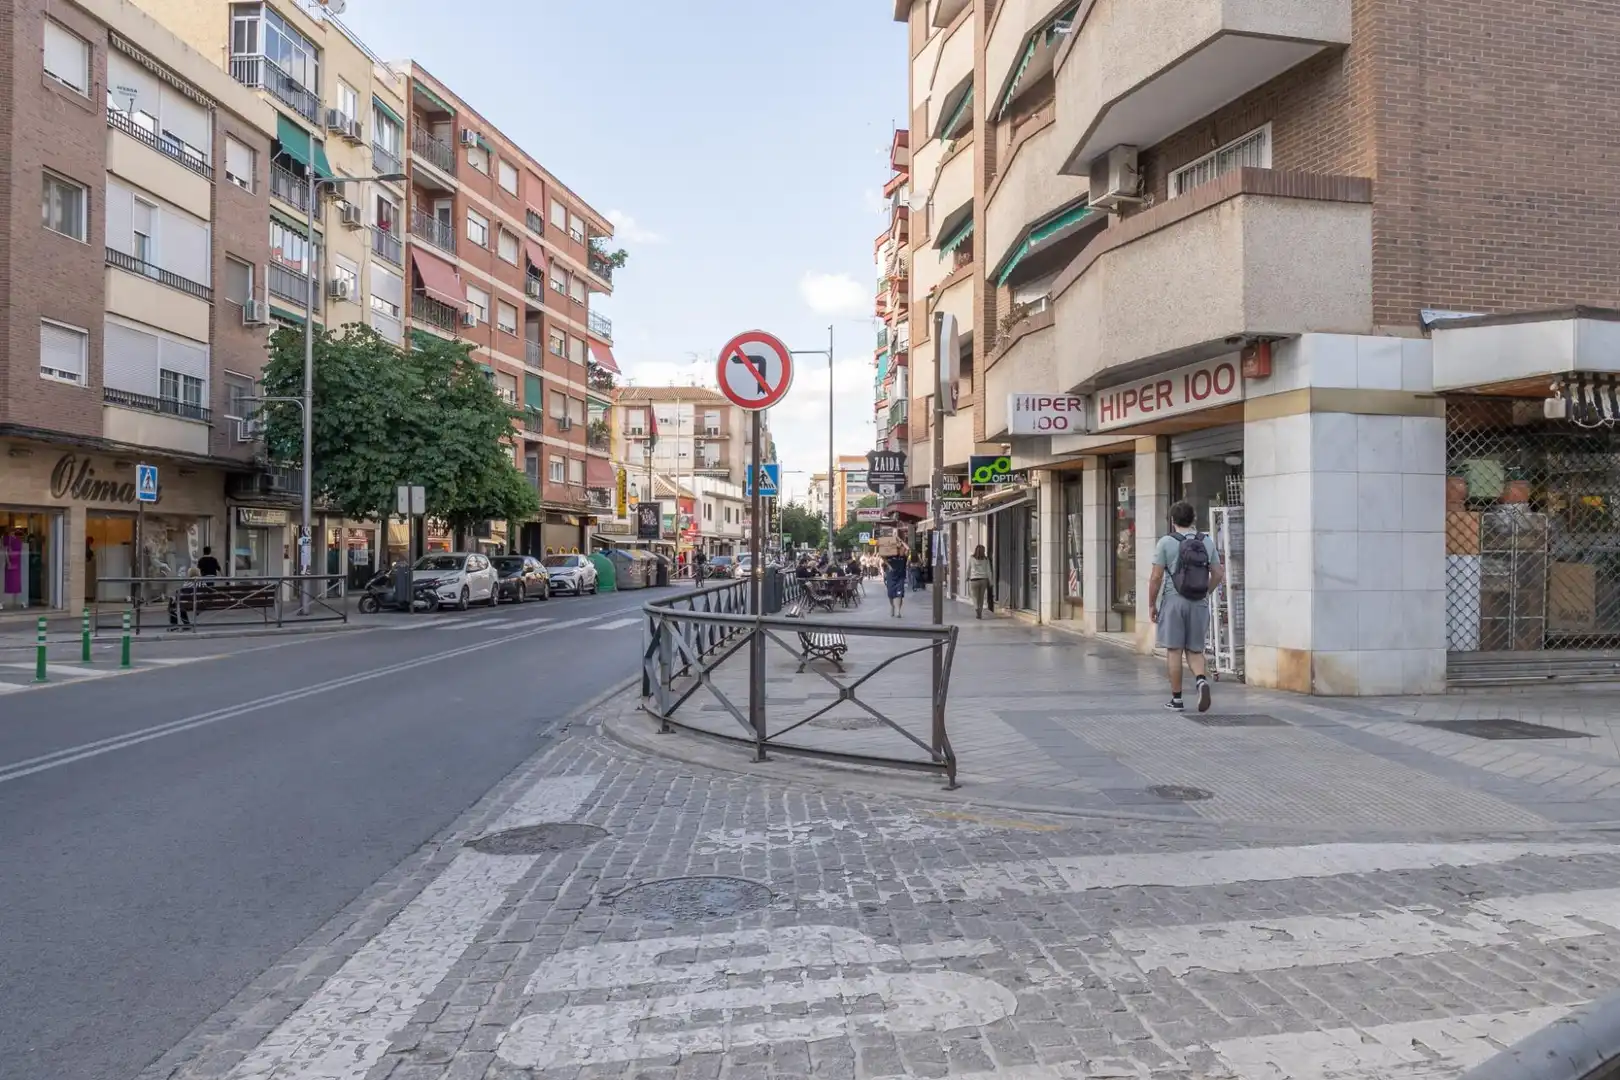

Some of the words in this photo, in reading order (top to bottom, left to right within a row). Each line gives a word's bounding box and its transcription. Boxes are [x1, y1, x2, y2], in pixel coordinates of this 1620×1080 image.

[1100, 379, 1174, 424] HIPER
[1184, 362, 1236, 404] 100
[1016, 397, 1082, 412] HIPER
[874, 456, 900, 472] ZAIDA
